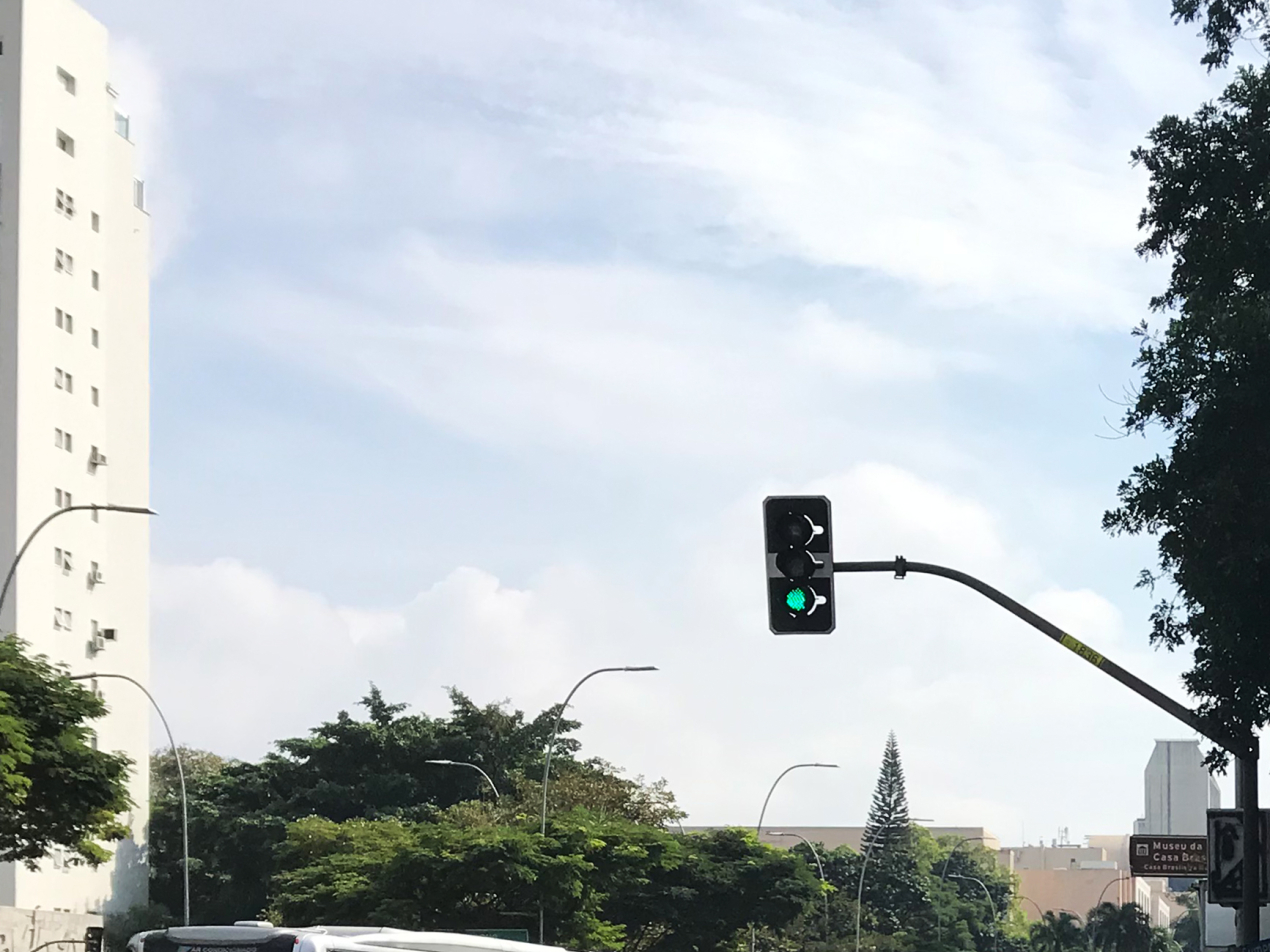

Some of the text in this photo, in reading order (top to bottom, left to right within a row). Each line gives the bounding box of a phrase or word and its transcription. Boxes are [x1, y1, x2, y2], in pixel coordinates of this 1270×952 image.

[1153, 842, 1203, 850] Museu da
[1153, 852, 1179, 861] Casa
